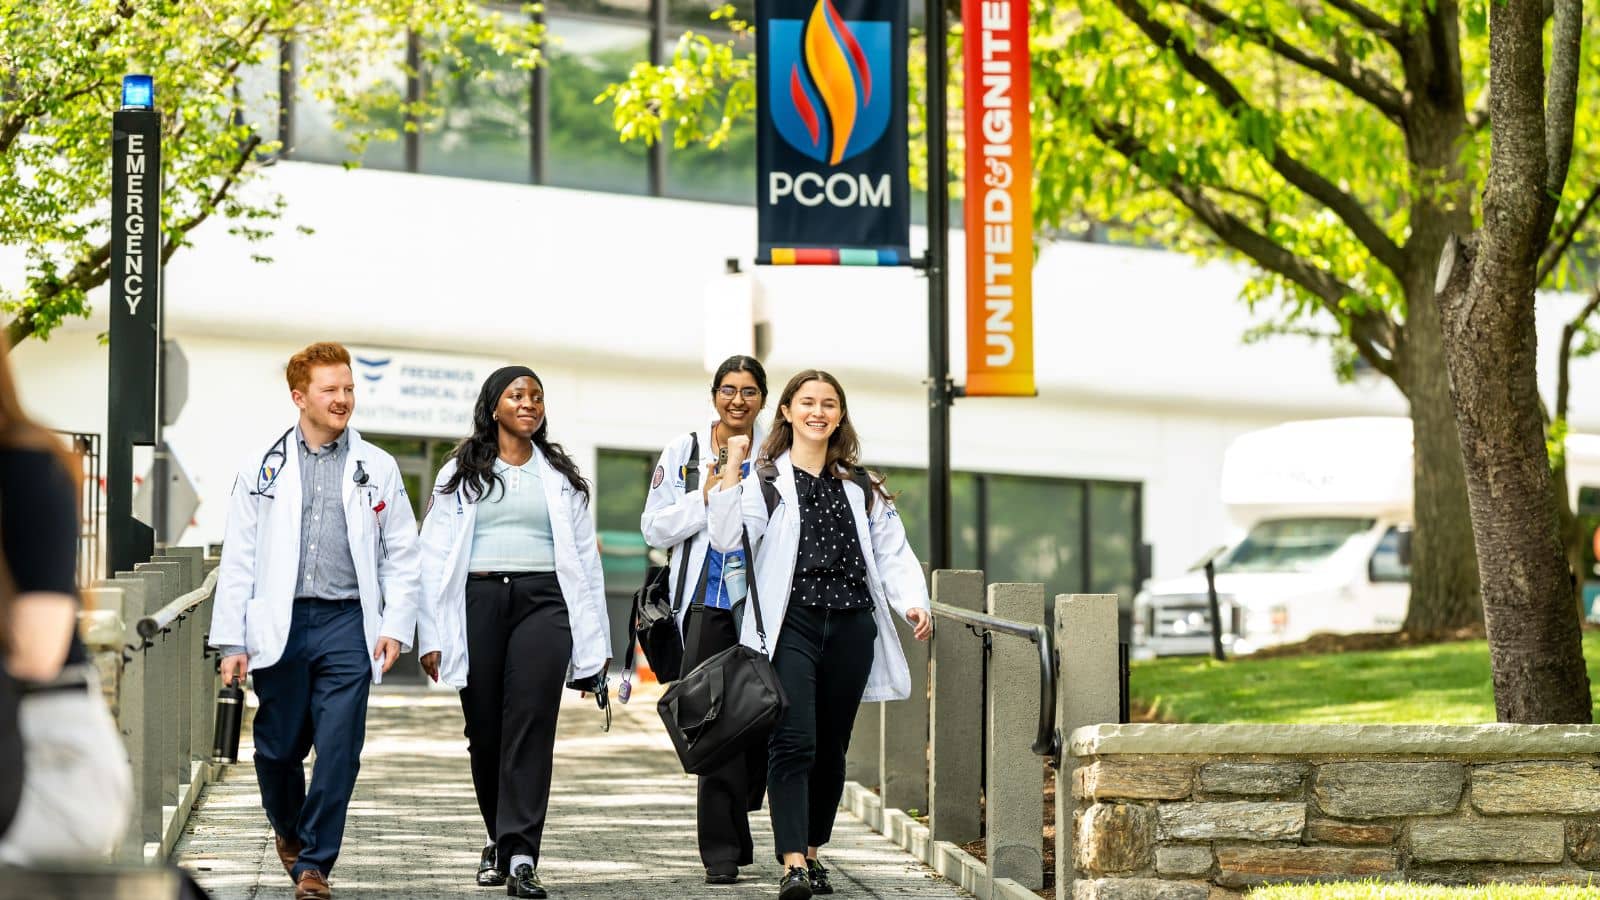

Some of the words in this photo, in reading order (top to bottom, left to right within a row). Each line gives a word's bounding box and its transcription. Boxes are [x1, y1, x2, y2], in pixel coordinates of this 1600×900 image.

[769, 171, 891, 207] PCOM
[124, 134, 145, 315] EMERGENCY
[401, 385, 456, 400] MEDICAL
